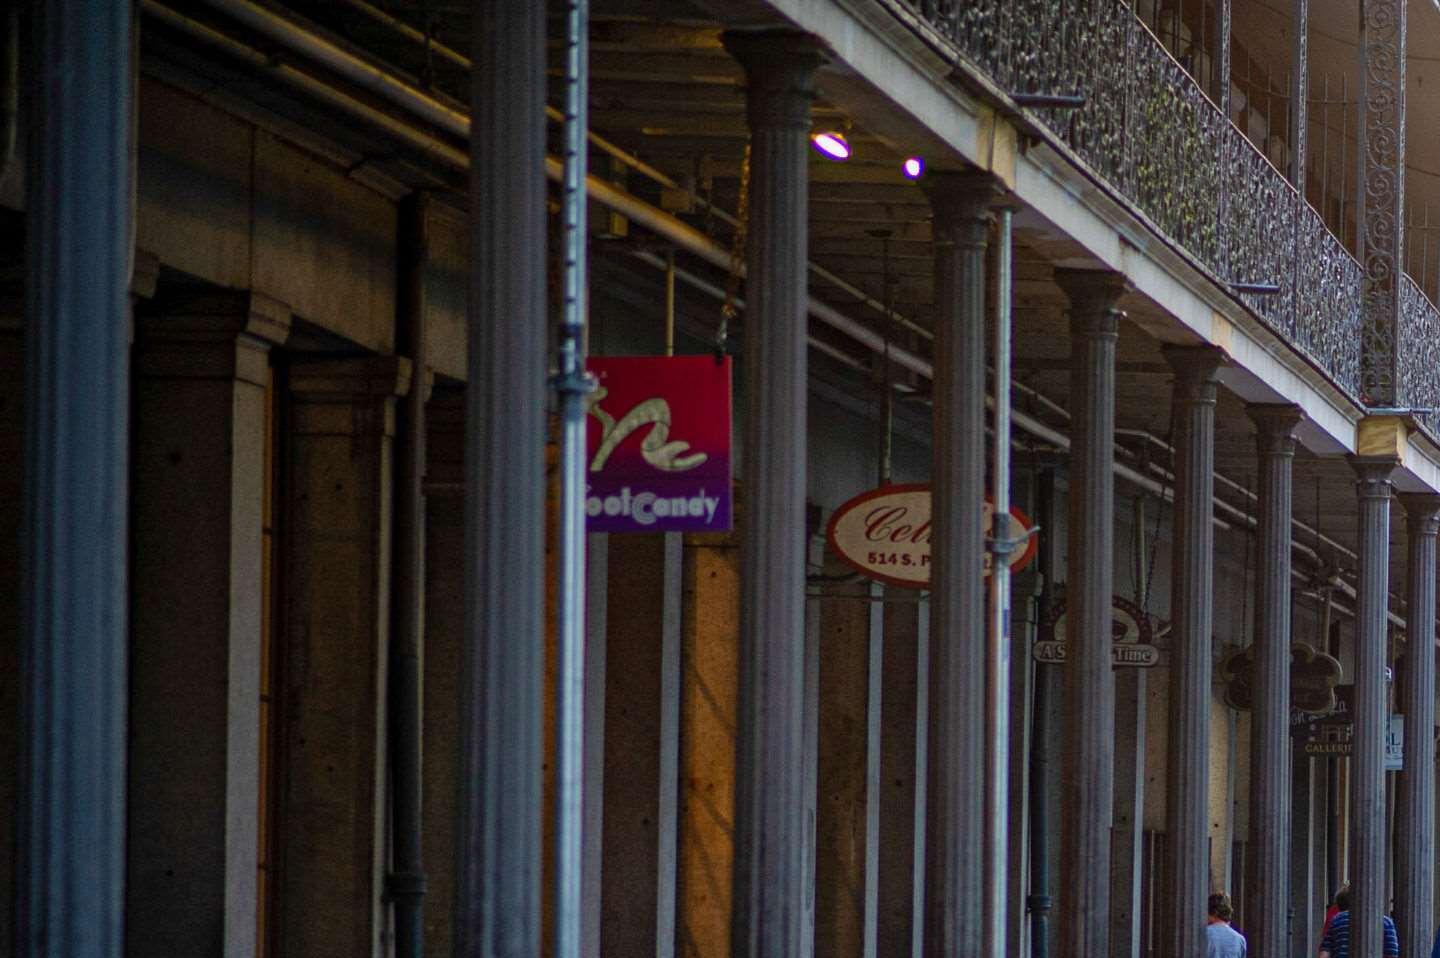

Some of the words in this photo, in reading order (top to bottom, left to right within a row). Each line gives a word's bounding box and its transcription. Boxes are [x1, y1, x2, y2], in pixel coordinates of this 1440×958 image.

[585, 485, 720, 525] ootCandy
[868, 552, 897, 566] 514
[901, 552, 917, 567] S.
